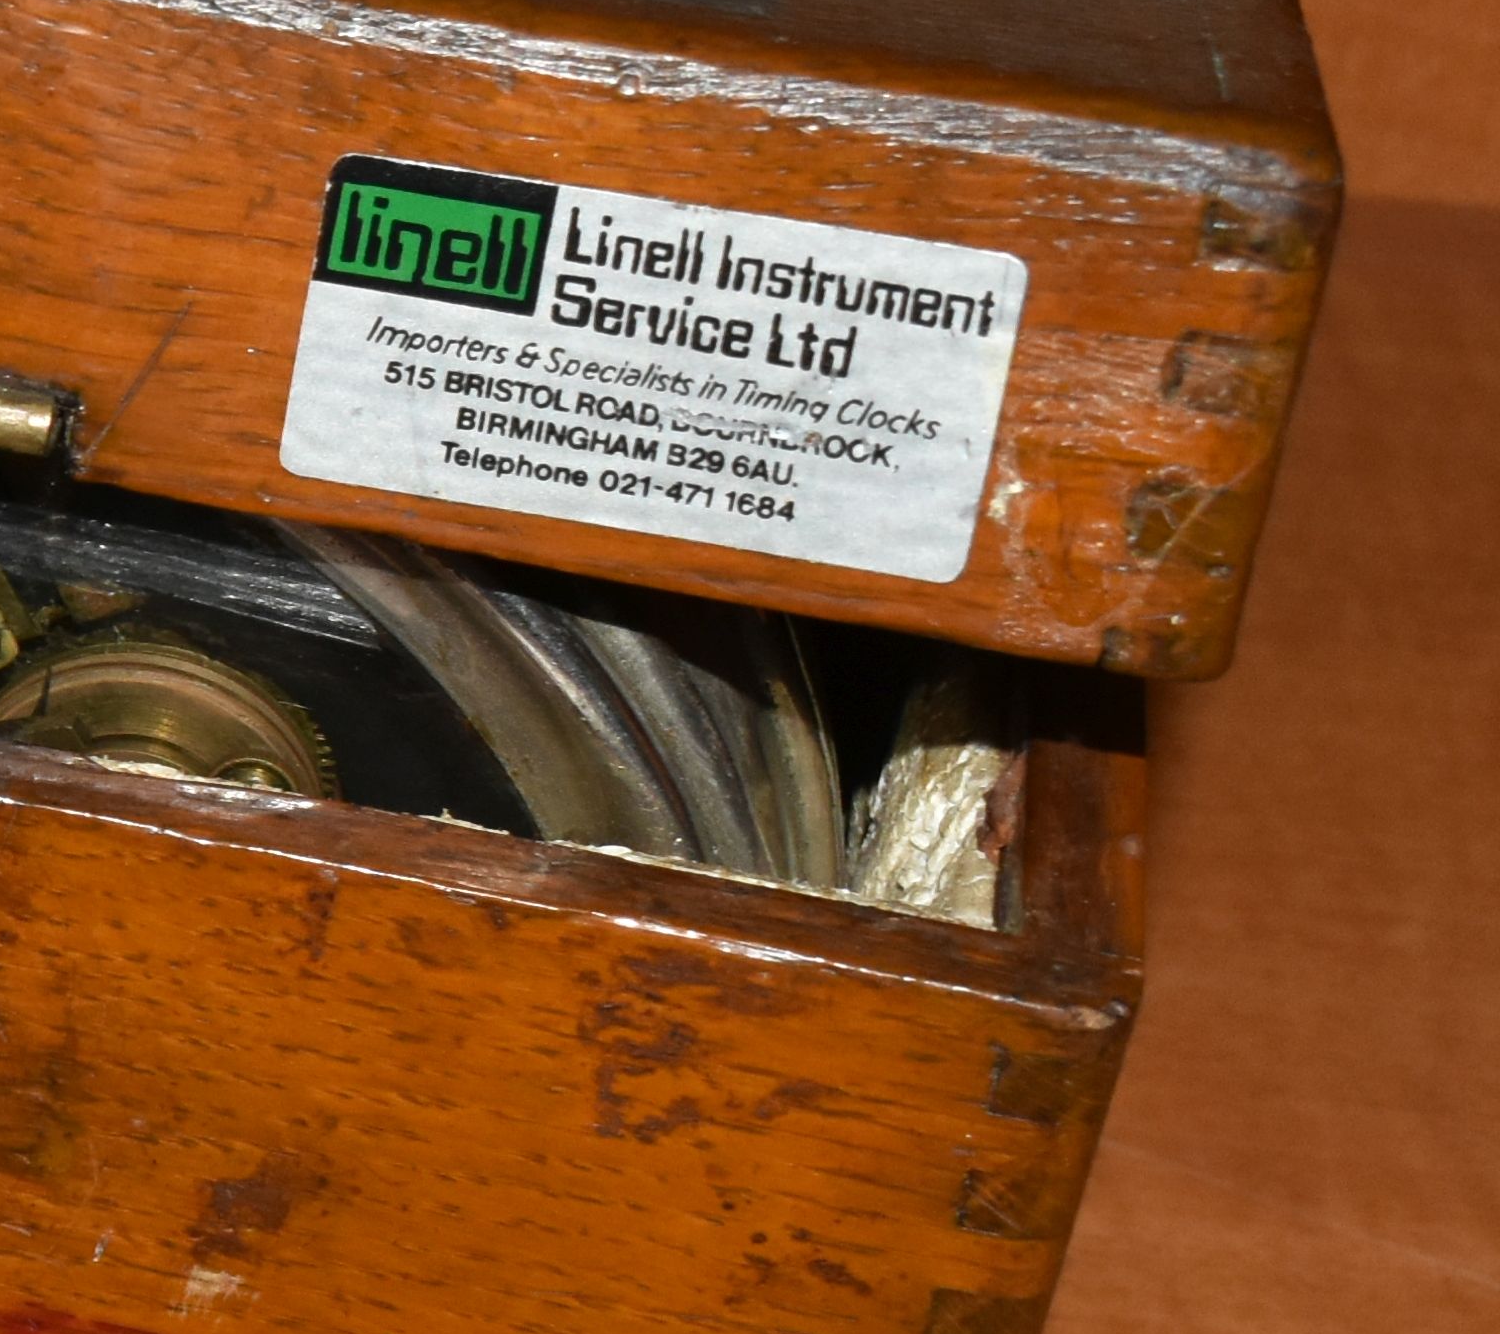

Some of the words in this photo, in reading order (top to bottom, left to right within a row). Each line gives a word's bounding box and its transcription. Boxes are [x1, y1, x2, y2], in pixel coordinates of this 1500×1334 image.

[340, 190, 528, 295] linell
[563, 206, 704, 285] Linell
[716, 234, 995, 337] Instrument
[366, 315, 509, 364] Importers
[515, 342, 541, 369] &
[544, 347, 694, 397] Specialists
[698, 373, 728, 401] in
[733, 378, 831, 423] Timing
[836, 398, 943, 440] Clocks
[551, 273, 755, 358] Service
[766, 313, 858, 378] Ltd
[383, 360, 436, 390] 515
[444, 370, 570, 413] BRISTOL
[575, 392, 664, 433] ROAD,
[456, 407, 659, 462] BIRMINGHAM
[666, 442, 725, 473] B29
[731, 455, 799, 488] 6AU.
[441, 440, 589, 488] Telephone
[599, 469, 715, 508] 021-471
[725, 490, 796, 522] 1684
